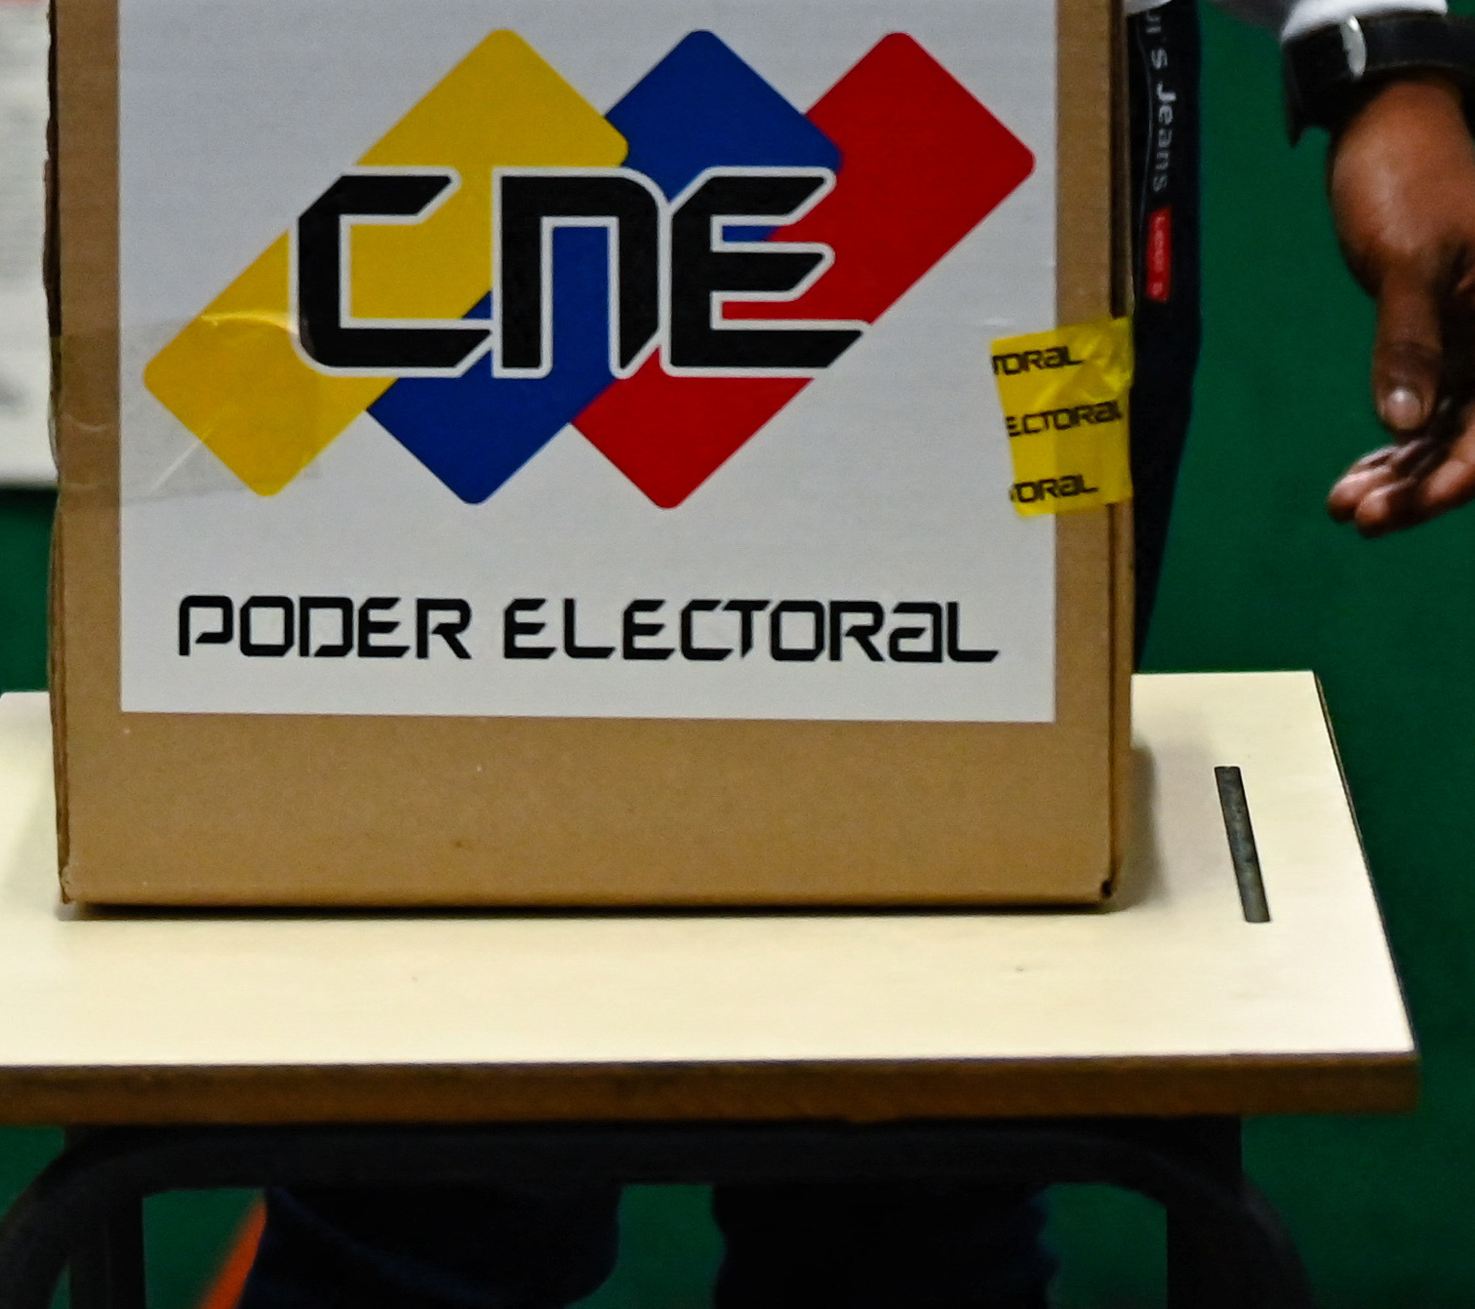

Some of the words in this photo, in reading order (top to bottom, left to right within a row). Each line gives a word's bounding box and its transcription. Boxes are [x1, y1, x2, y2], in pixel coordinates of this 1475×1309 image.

[1153, 83, 1177, 194] Jeans
[295, 171, 867, 374] CNE
[178, 594, 472, 660] PODER
